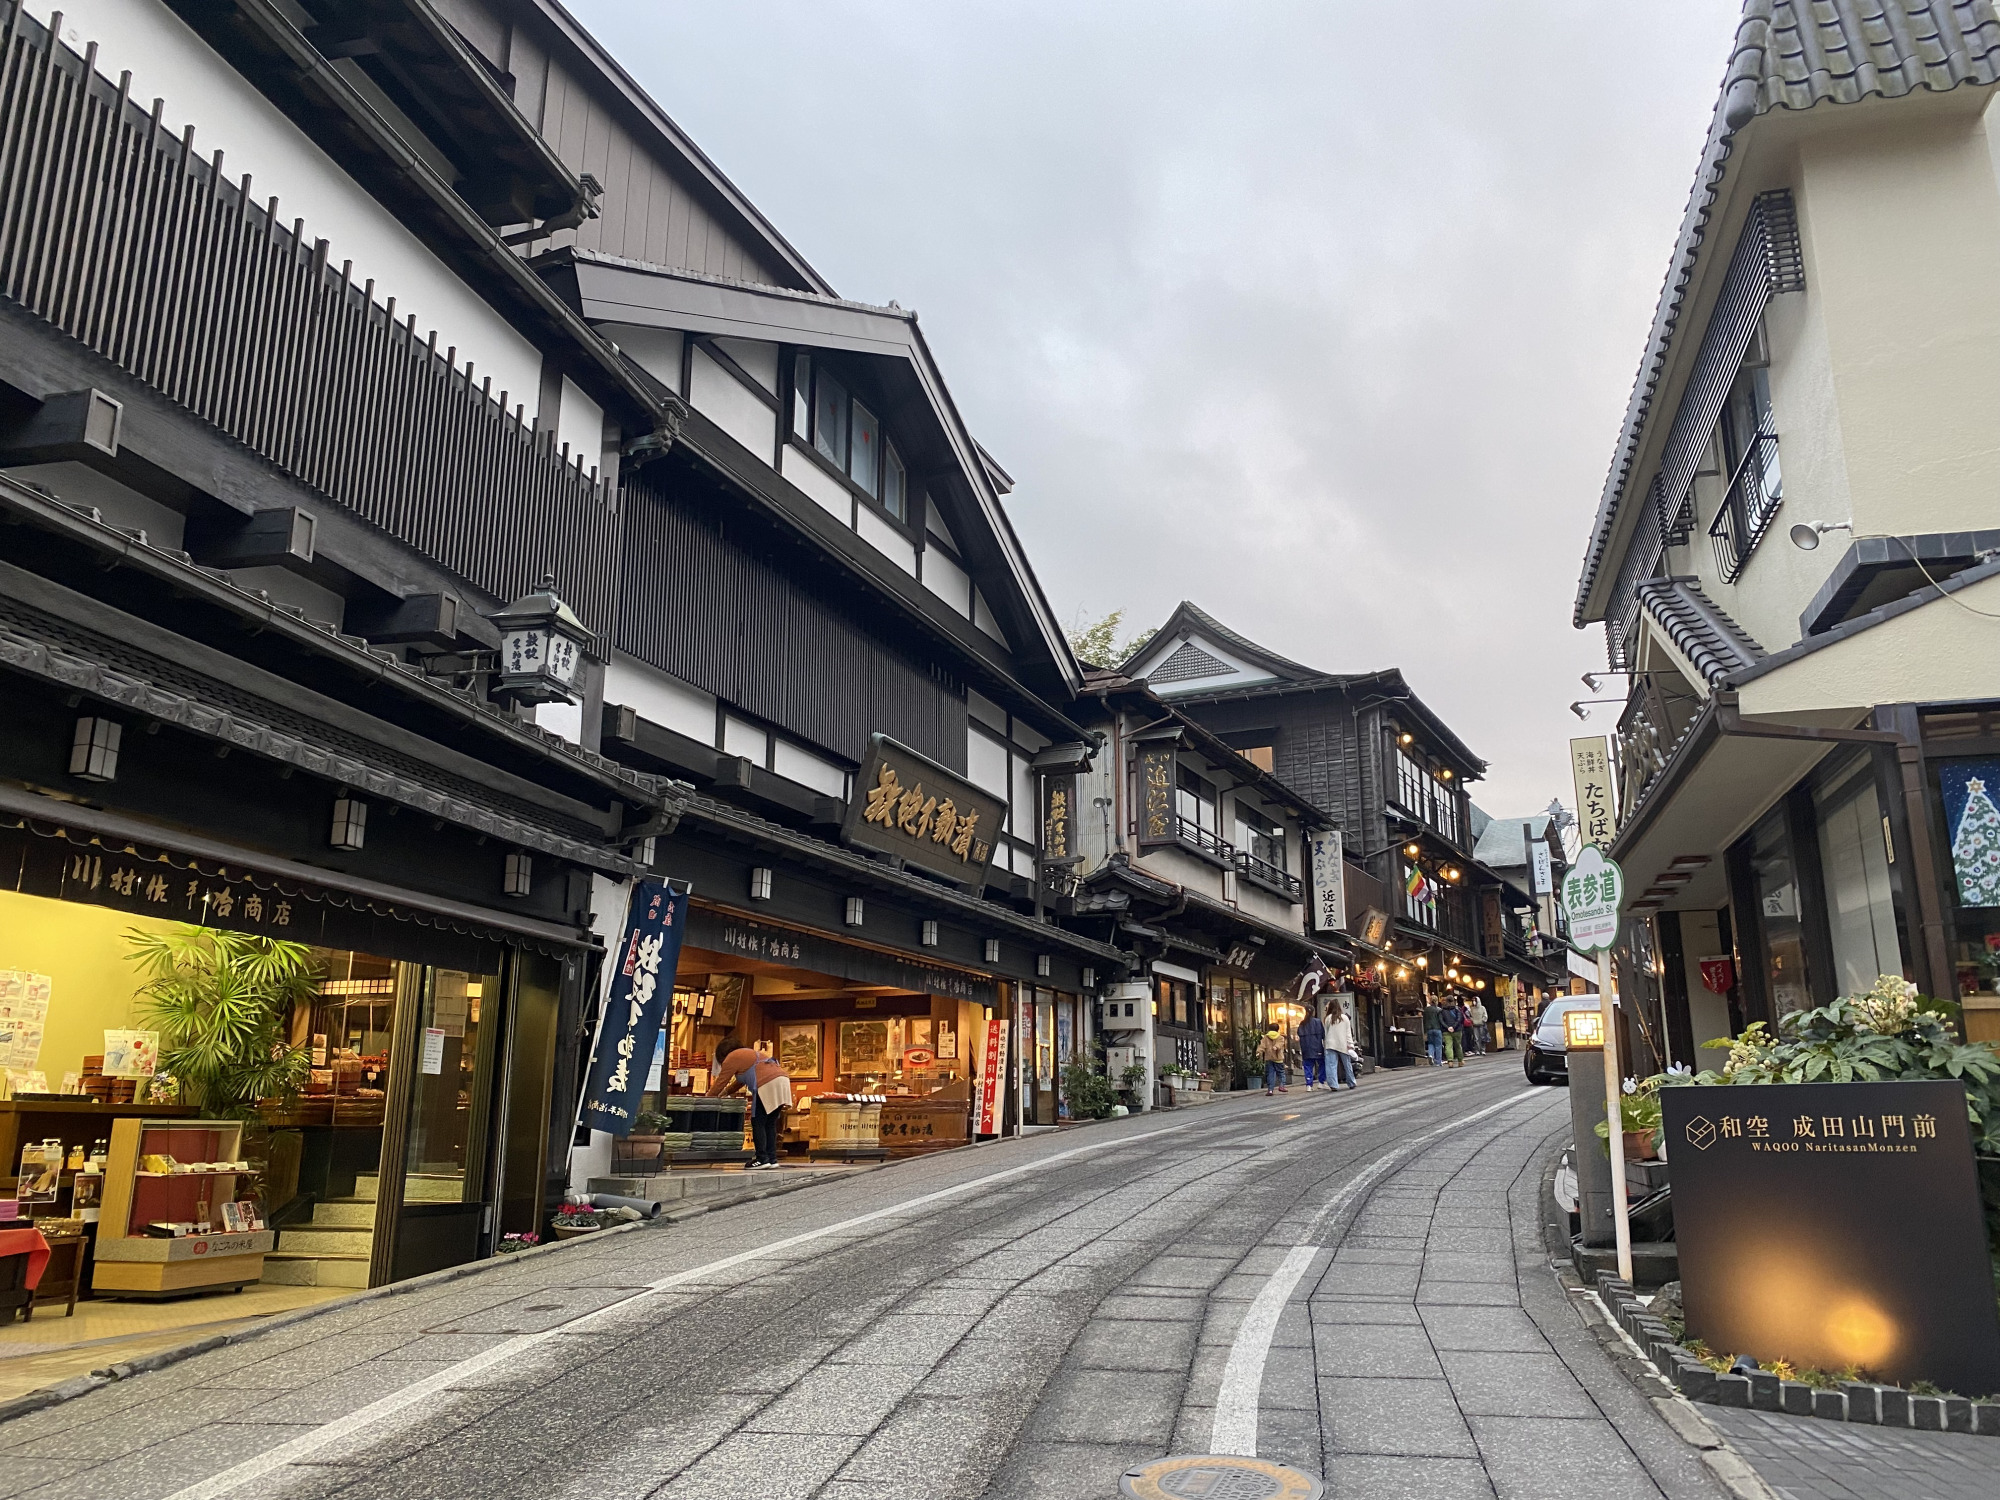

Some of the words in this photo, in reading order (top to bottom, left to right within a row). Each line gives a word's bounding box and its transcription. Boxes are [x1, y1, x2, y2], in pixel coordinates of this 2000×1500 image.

[1577, 752, 1586, 774] 天ぷら
[1585, 751, 1596, 773] 海鮮丼
[1596, 750, 1605, 773] うなぎ
[1314, 841, 1328, 889] 天ぷら
[1327, 832, 1340, 883] うなぎ
[1567, 868, 1616, 910] 表参道
[1322, 889, 1337, 928] 近江屋
[1571, 906, 1604, 921] Omotesando
[1605, 904, 1614, 914] St.
[982, 1024, 999, 1124] 送料割引サービス
[974, 1072, 984, 1126] 川村佐平治商店
[1719, 1115, 1770, 1139] 和空
[1793, 1114, 1937, 1139] 成田山門前
[1751, 1142, 1800, 1153] WAQOO
[1805, 1142, 1918, 1153] NaritasanMonzen
